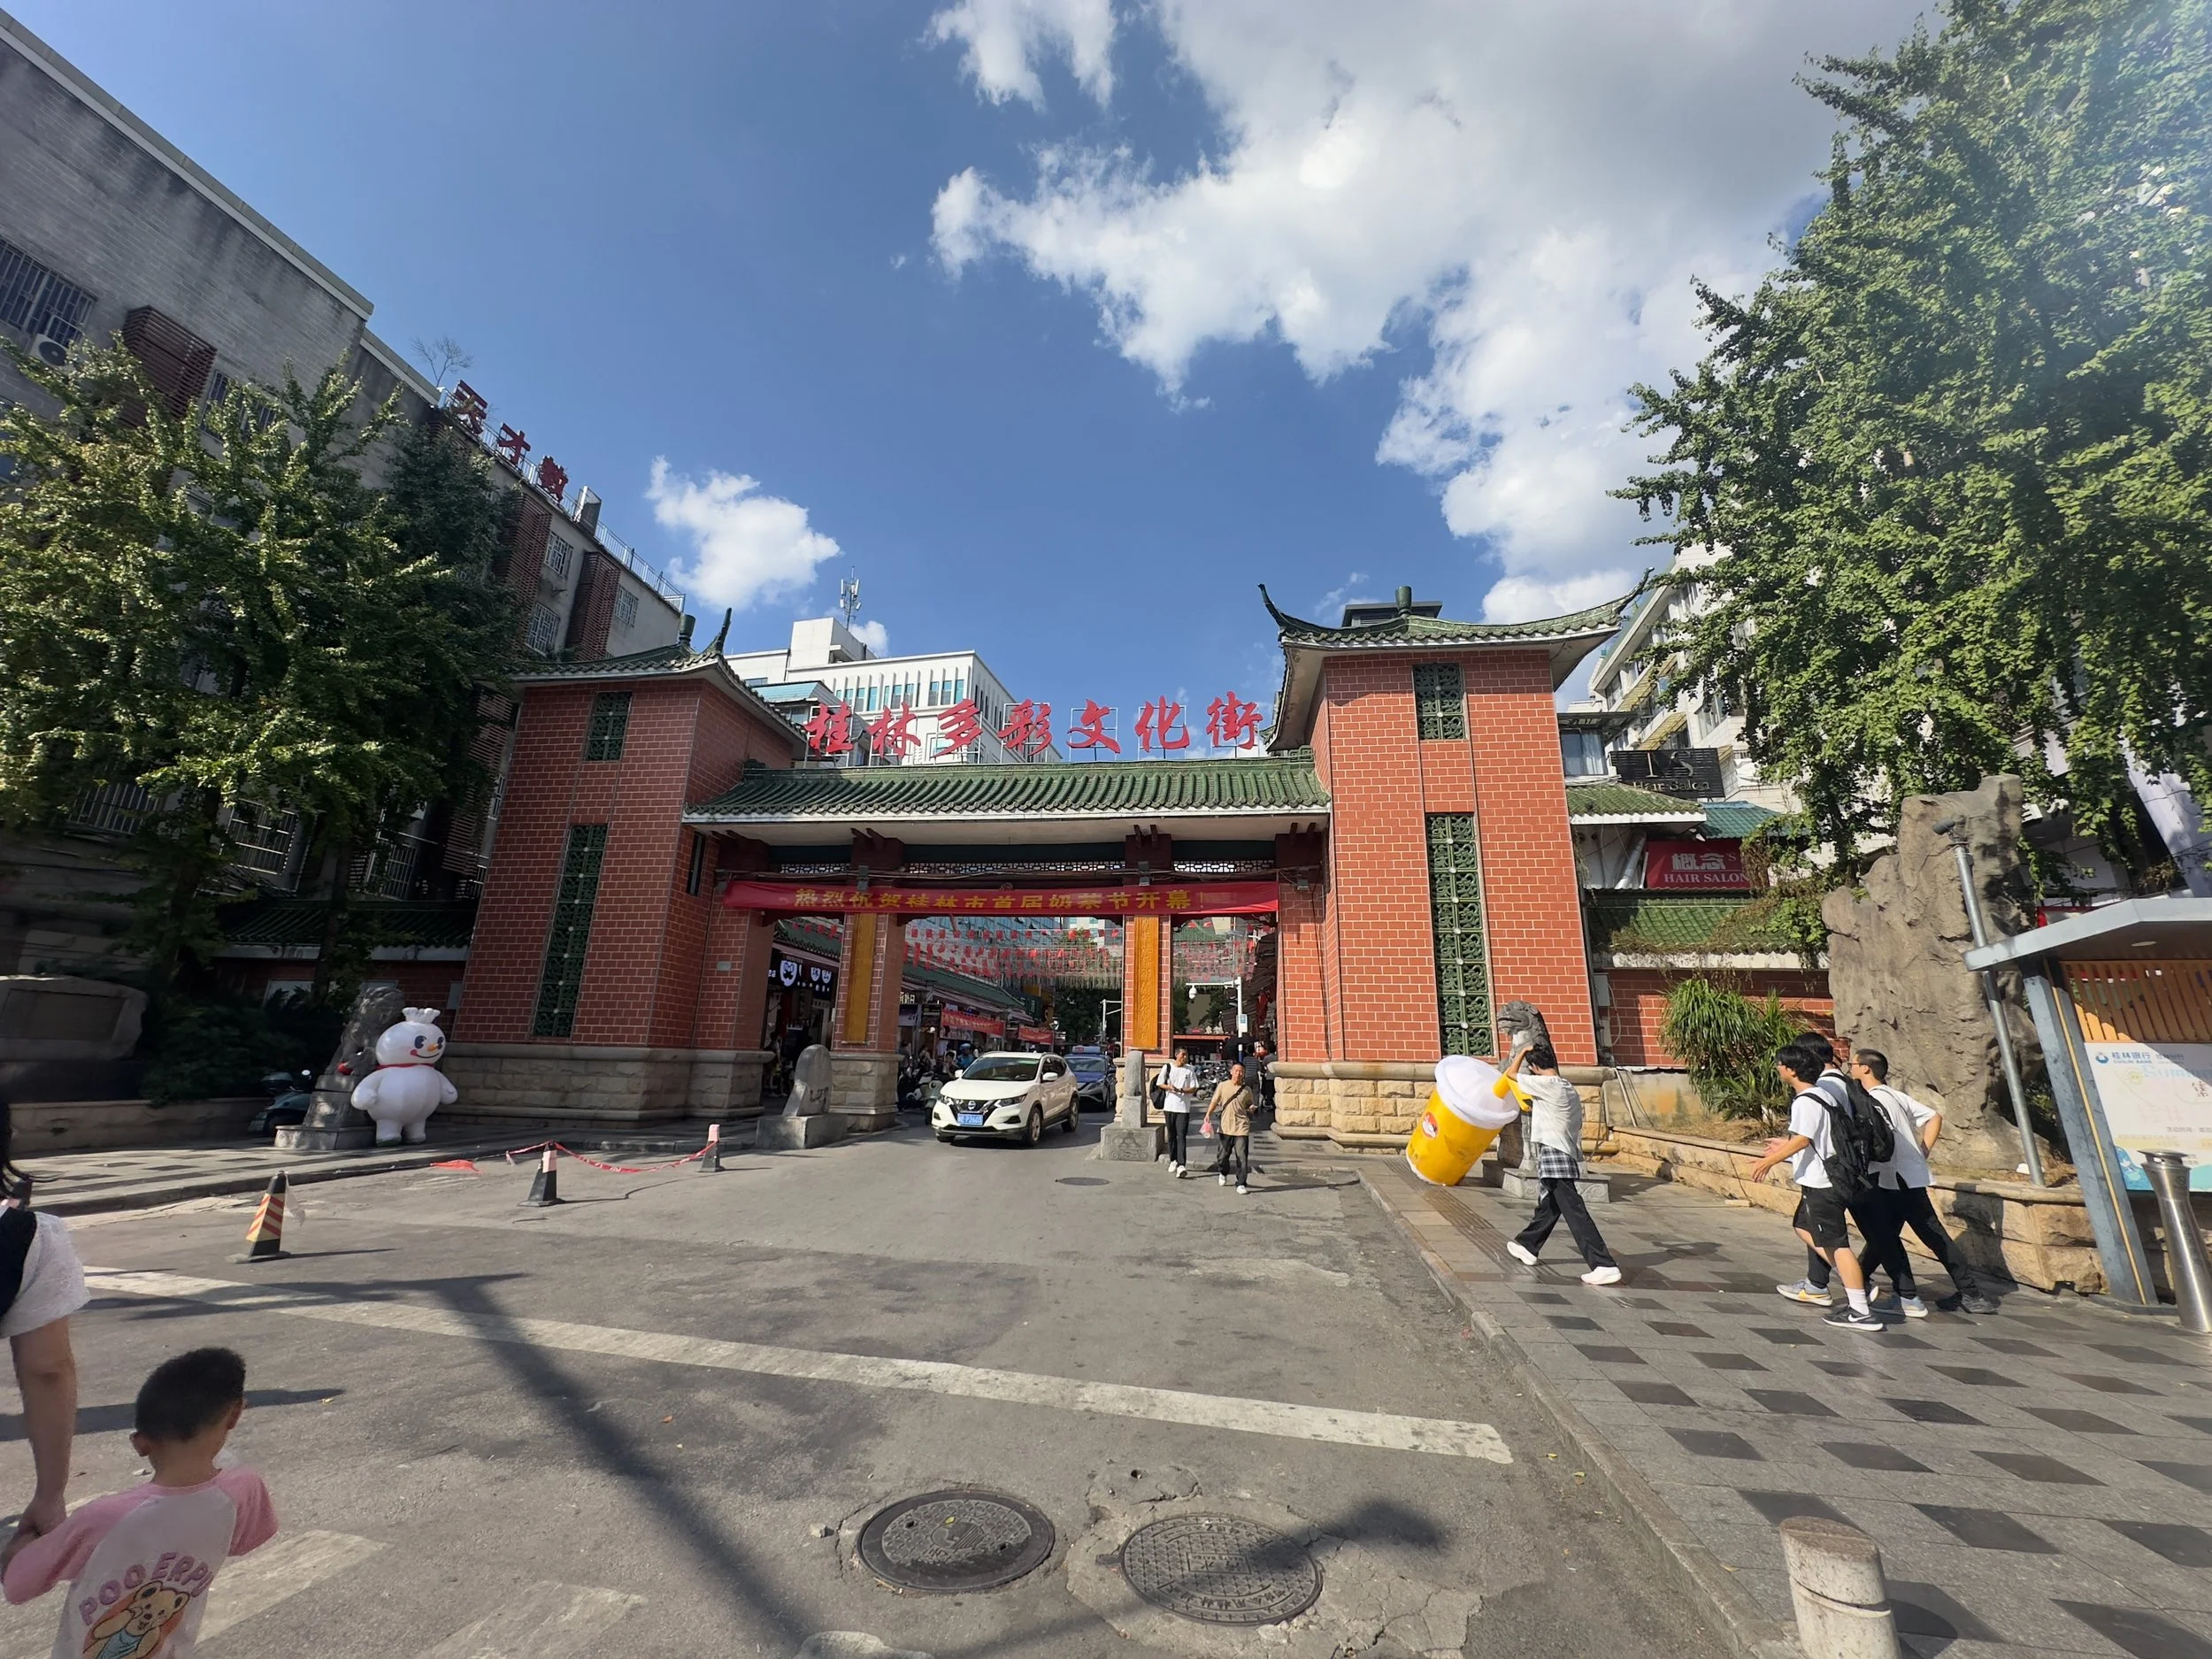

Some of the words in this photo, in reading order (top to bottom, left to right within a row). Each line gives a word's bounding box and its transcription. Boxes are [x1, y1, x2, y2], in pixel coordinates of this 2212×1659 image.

[803, 690, 1263, 760] 桂林多彩文化街
[1669, 780, 1710, 792] Salon
[1663, 872, 1701, 883] HAIR
[1703, 872, 1751, 883] SALON
